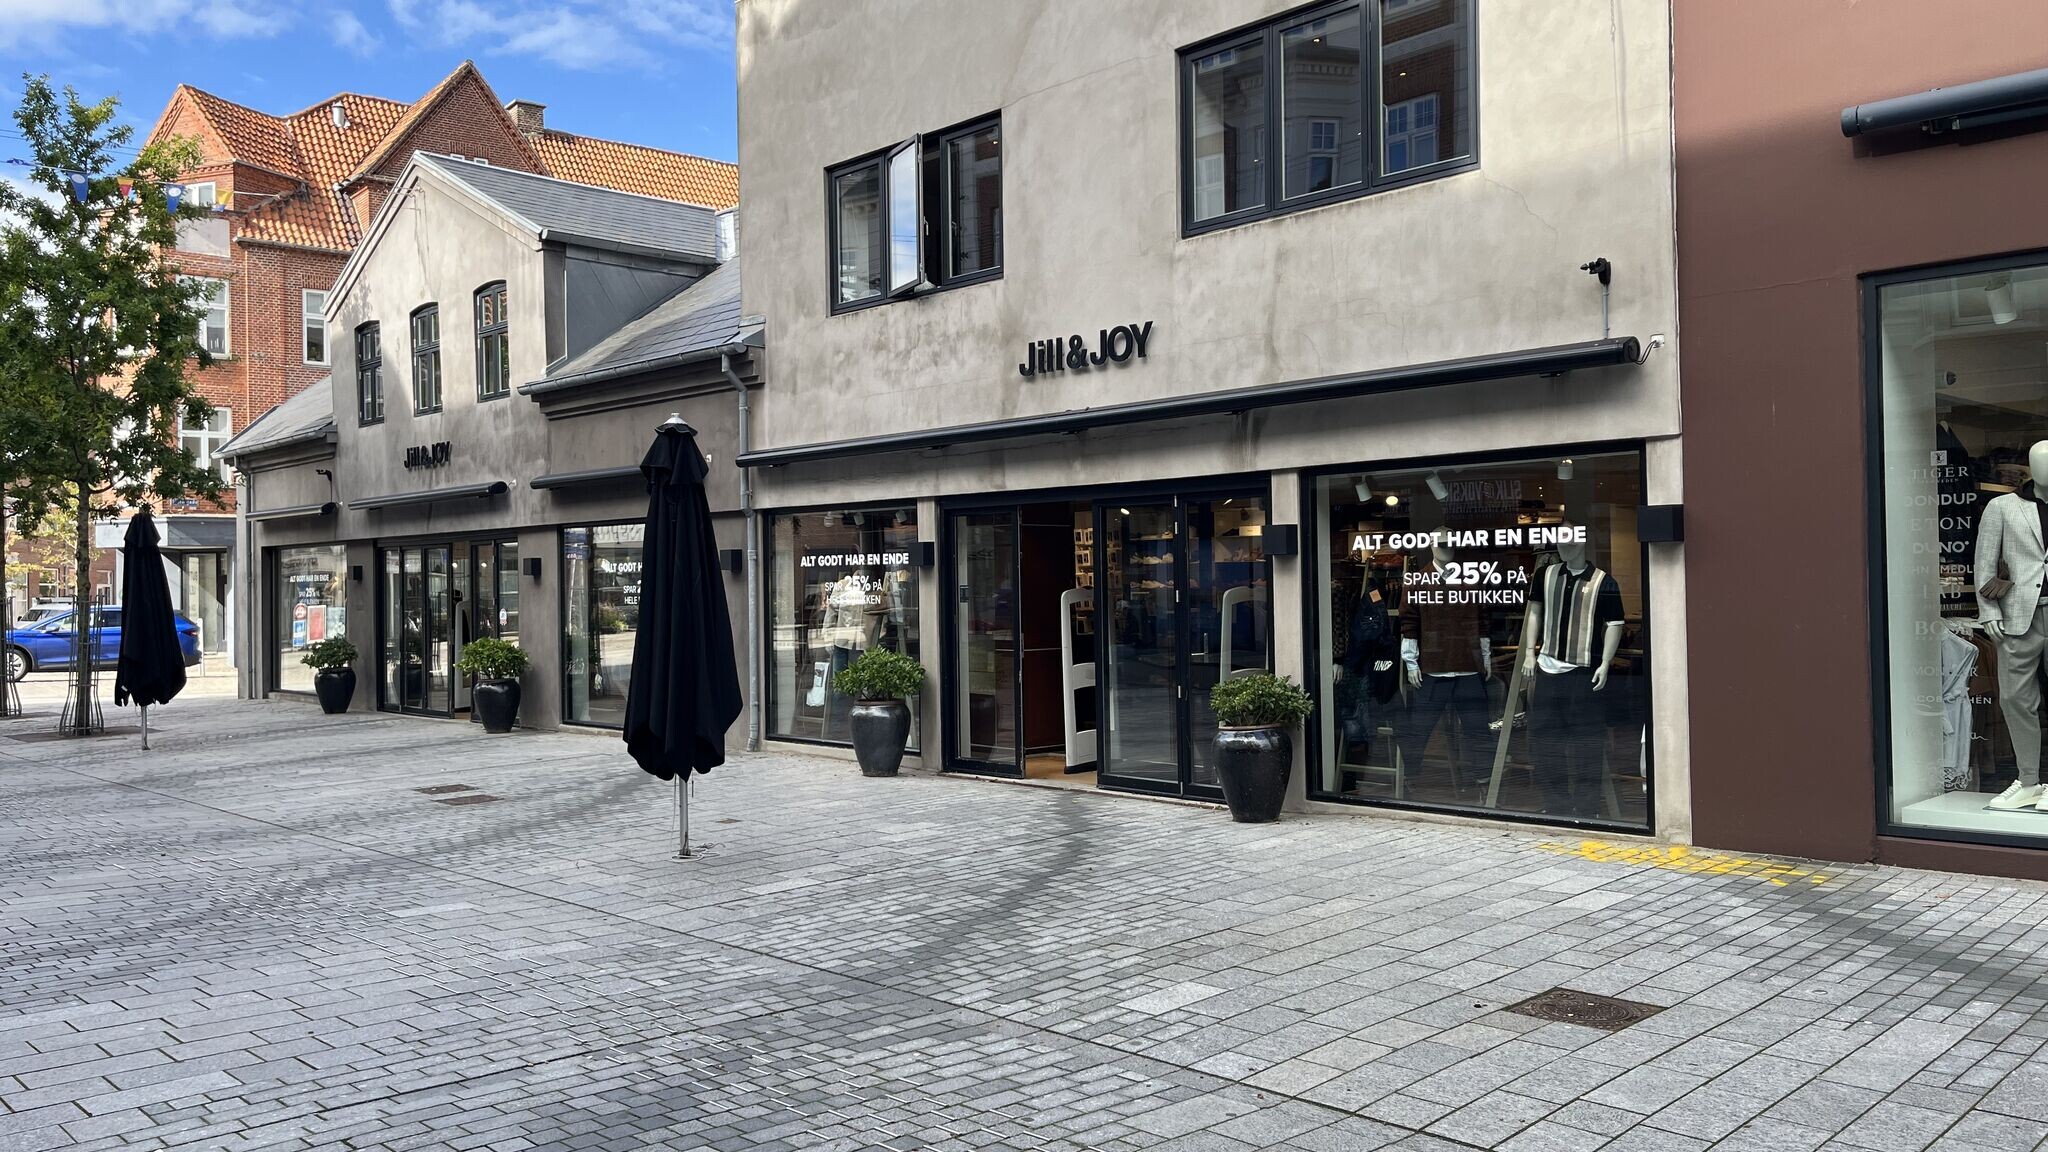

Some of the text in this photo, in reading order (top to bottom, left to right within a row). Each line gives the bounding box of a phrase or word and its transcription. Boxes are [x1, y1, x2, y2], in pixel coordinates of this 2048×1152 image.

[1911, 466, 1968, 479] TIGER
[1911, 516, 1972, 531] ETON
[1352, 526, 1587, 551] ALT GODT HAR EN ENDE
[800, 553, 909, 567] ALT GODT HAR EN ENDE
[618, 562, 637, 573] GODT
[1403, 561, 1528, 585] SPAR 25% PÅ
[623, 585, 637, 593] SPAR
[844, 575, 871, 592] 25%
[872, 578, 883, 591] PÅ
[624, 596, 638, 604] HELE
[1407, 590, 1524, 604] HELE BUTIKKEN
